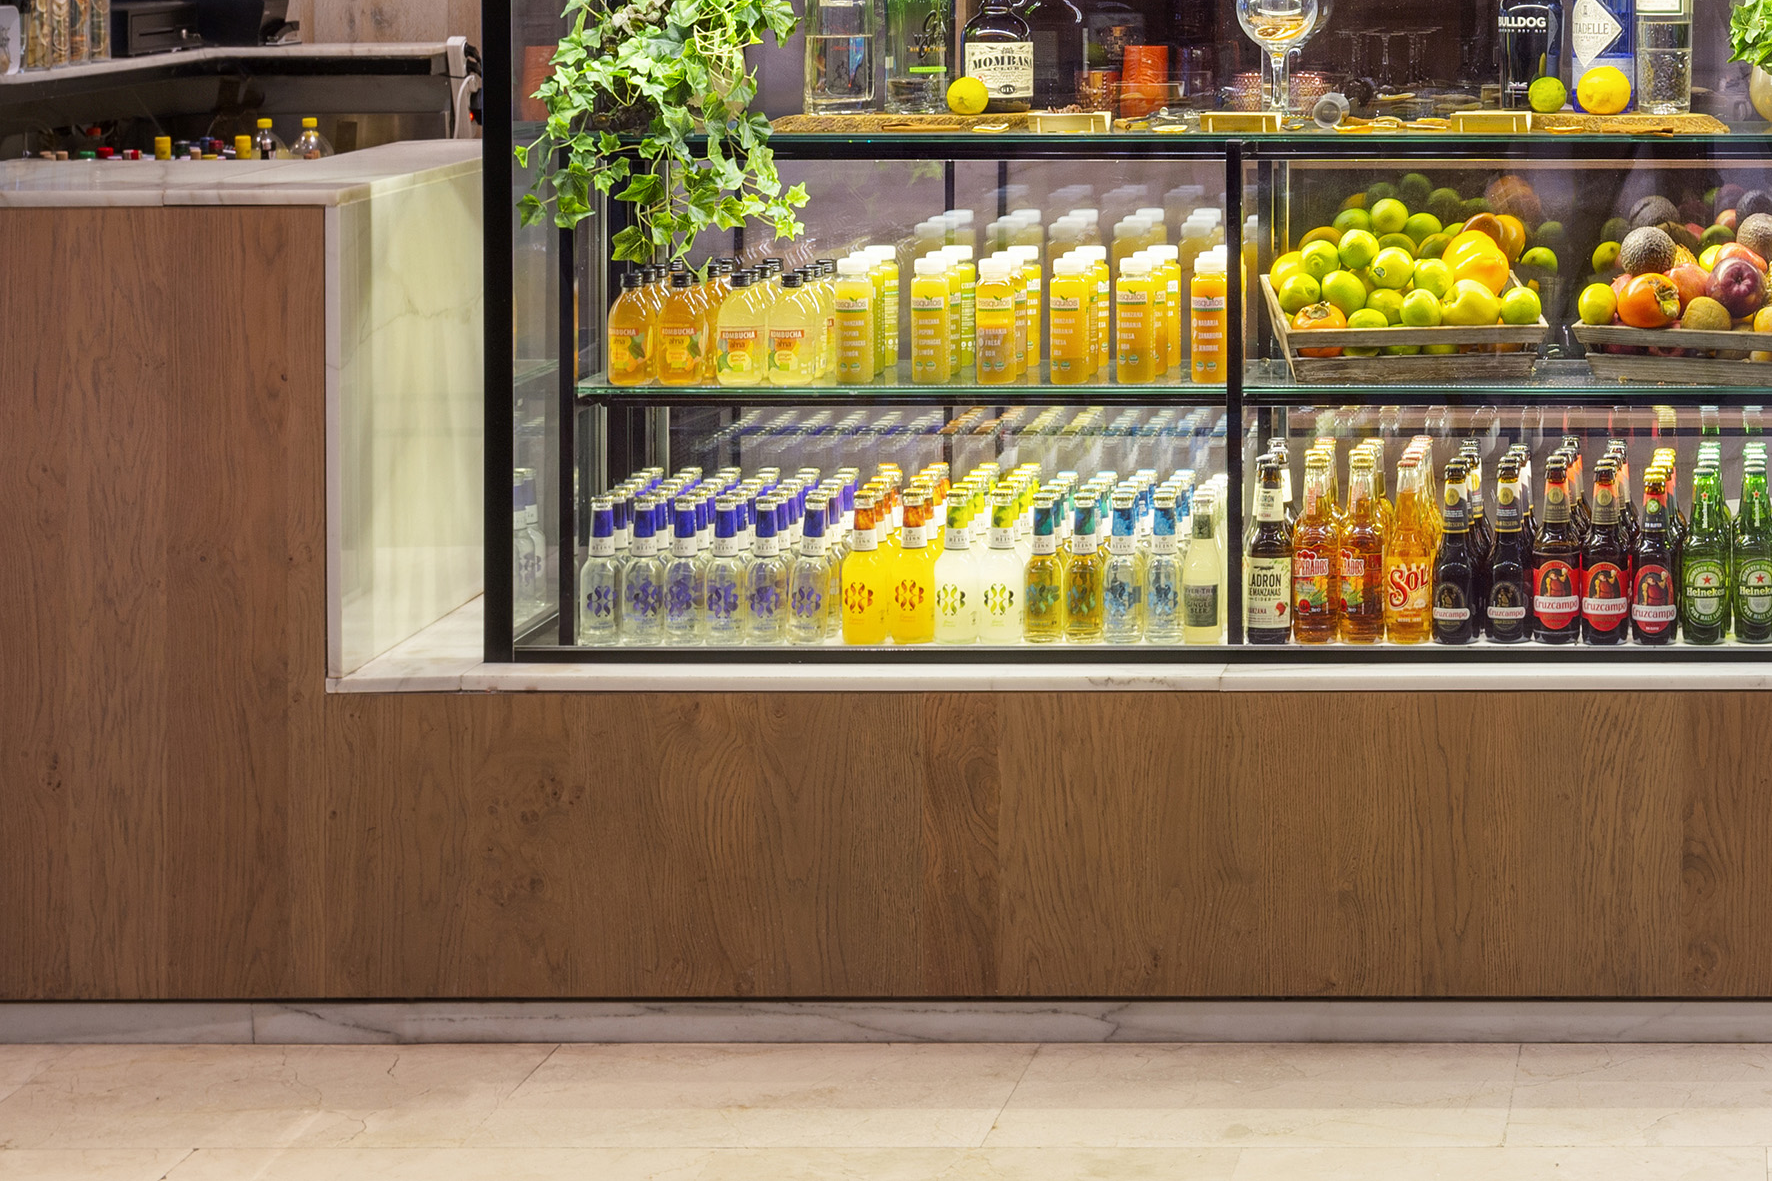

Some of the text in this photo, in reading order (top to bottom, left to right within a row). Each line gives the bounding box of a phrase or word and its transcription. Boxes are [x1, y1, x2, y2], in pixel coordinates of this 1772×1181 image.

[1498, 16, 1546, 28] BULLDOG
[1573, 23, 1609, 35] ITADELLE
[972, 55, 1032, 70] MOMBAS
[1001, 85, 1016, 93] GIN
[661, 328, 696, 336] KOMBUCHA
[722, 331, 756, 339] KOMBUCHA
[771, 330, 803, 339] KOMBUCHA
[1686, 587, 1724, 597] Heineken
[1536, 599, 1578, 610] Cruzcampo
[1583, 600, 1626, 611] Cruzcampo
[1434, 609, 1468, 619] Cruzcampo
[1489, 608, 1524, 618] Cruzcampo
[1632, 607, 1675, 619] Cruzcampo
